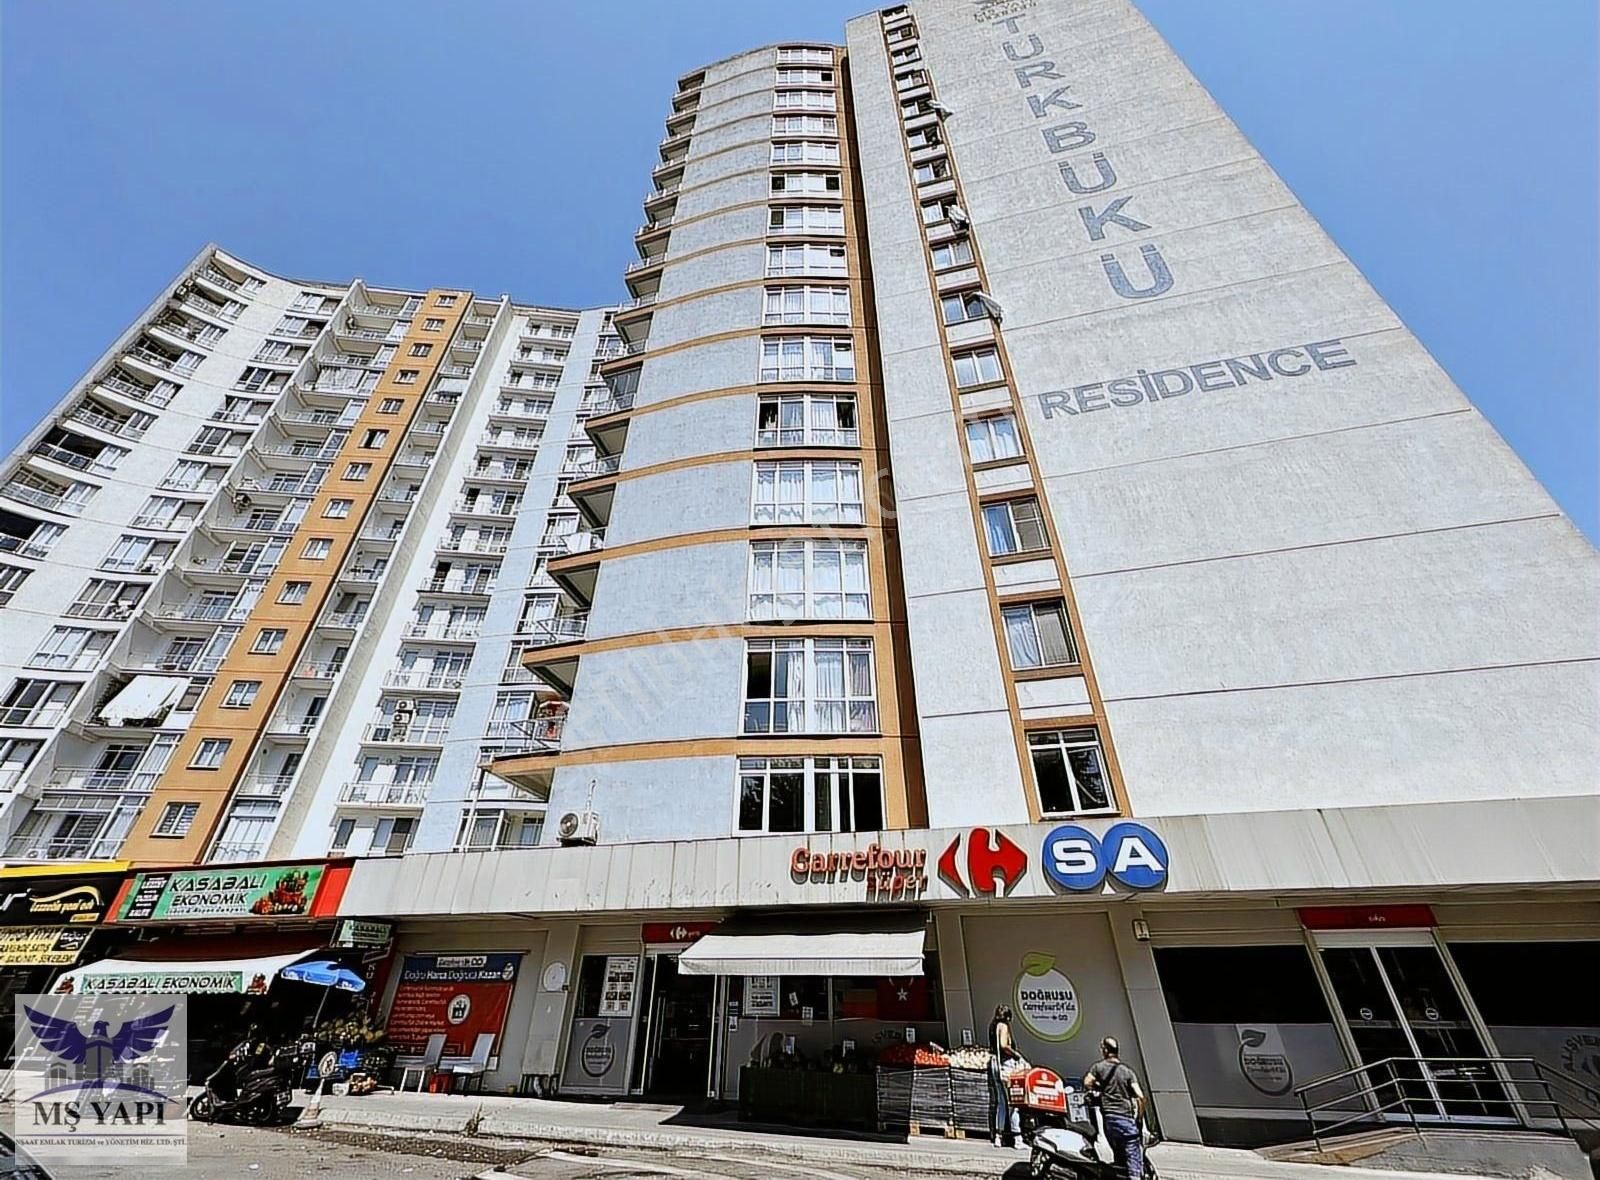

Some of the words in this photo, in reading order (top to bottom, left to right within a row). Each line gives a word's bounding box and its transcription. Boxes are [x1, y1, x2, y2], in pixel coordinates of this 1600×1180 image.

[1038, 339, 1357, 419] RESİDENCE
[791, 843, 927, 876] Carrefour
[1052, 836, 1165, 875] SA
[168, 875, 267, 892] KASABALI
[172, 891, 249, 906] EKONOMİK
[86, 977, 159, 990] KASABALI
[161, 975, 236, 990] EKONOMİK
[1021, 990, 1073, 1001] DOĞRUSU
